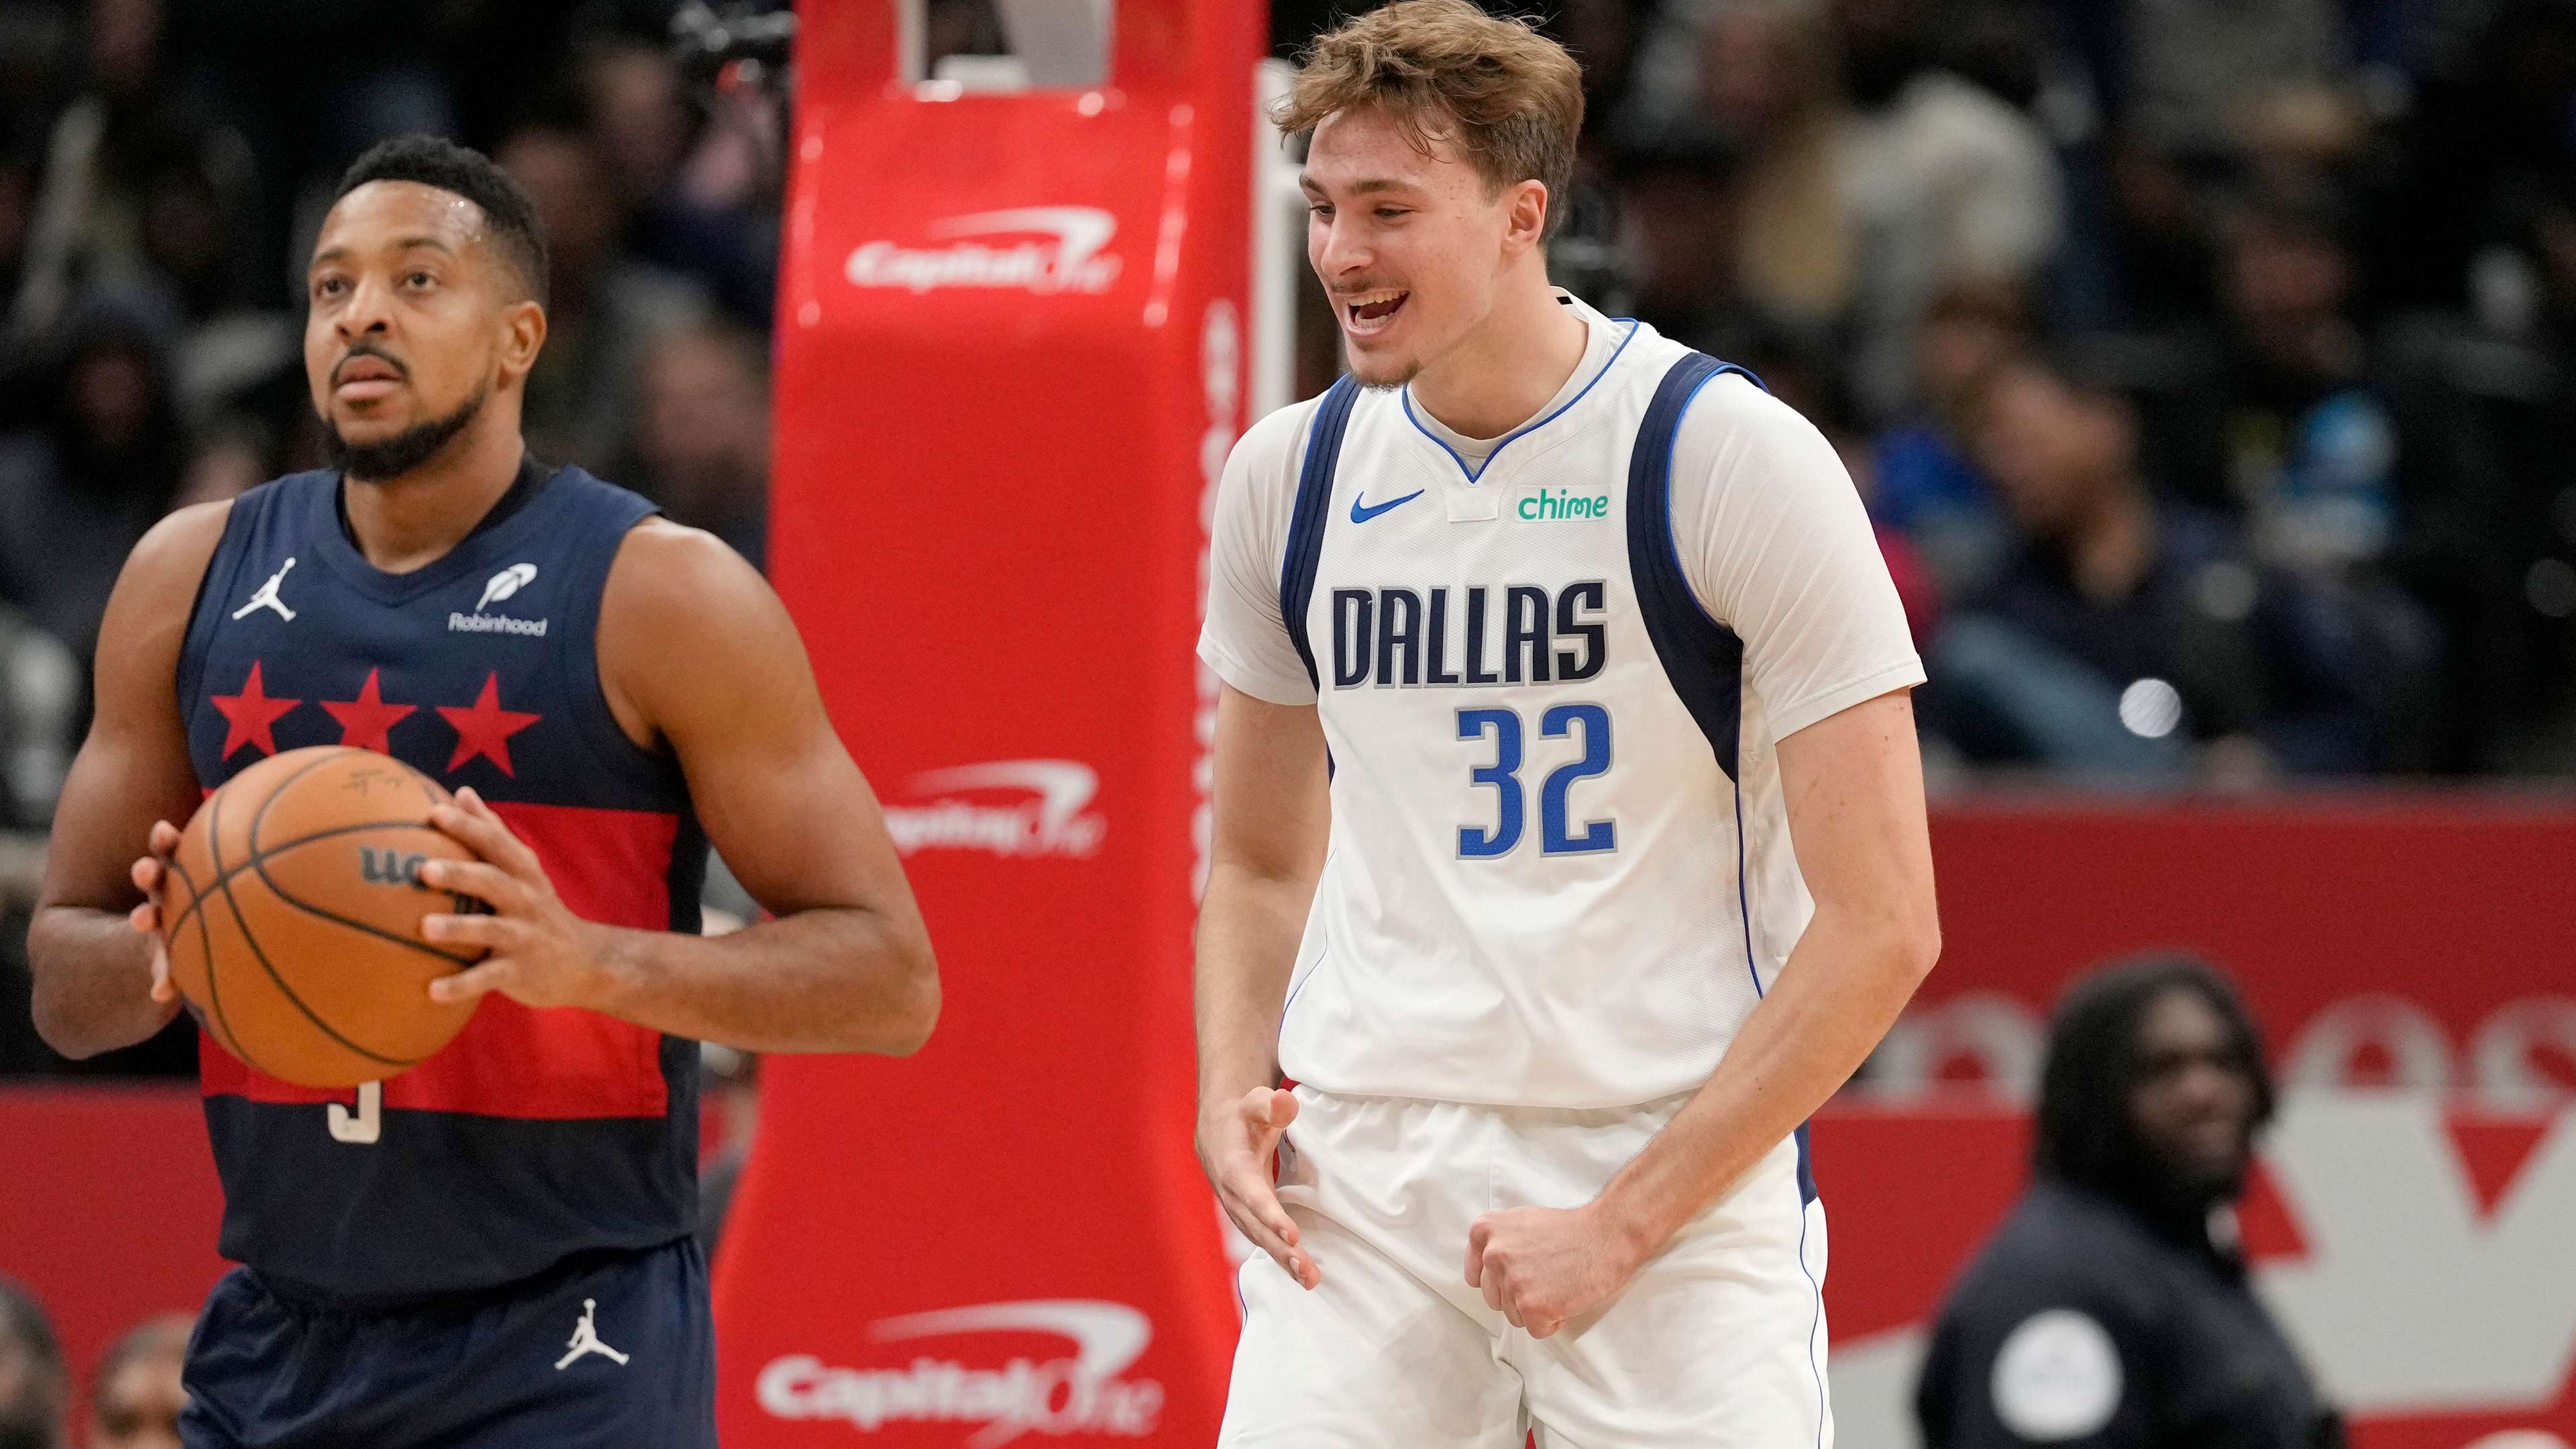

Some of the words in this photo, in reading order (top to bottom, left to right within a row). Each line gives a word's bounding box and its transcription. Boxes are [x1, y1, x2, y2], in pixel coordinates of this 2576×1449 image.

[1518, 488, 1609, 520] chime
[447, 612, 548, 637] Robinhood
[1330, 578, 1609, 691] DALLAS
[1454, 700, 1618, 861] 32
